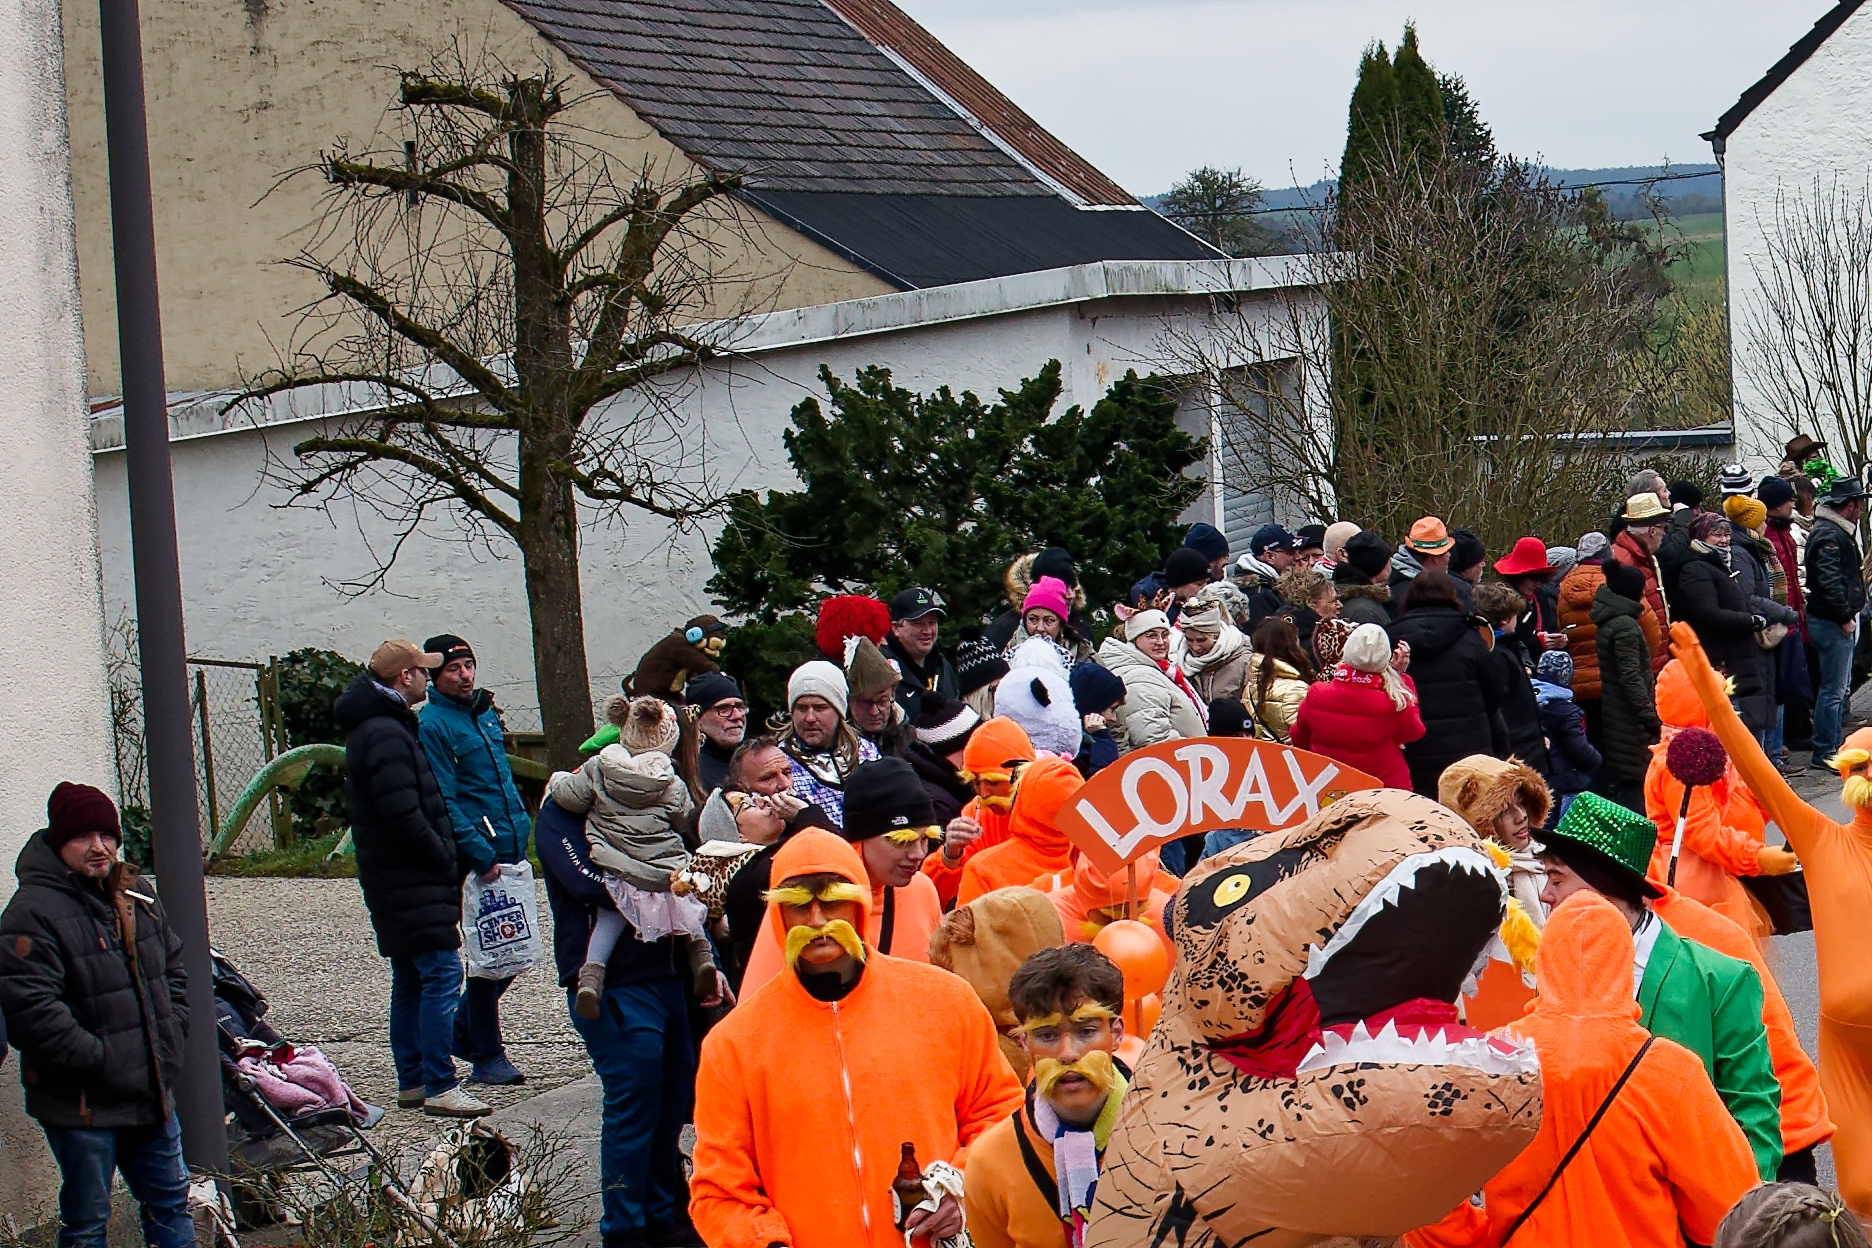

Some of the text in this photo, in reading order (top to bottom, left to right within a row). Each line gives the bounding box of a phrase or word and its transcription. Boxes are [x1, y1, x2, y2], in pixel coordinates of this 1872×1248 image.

[1075, 743, 1340, 860] LORAX
[480, 911, 523, 931] CENTER
[484, 921, 525, 943] SHOP
